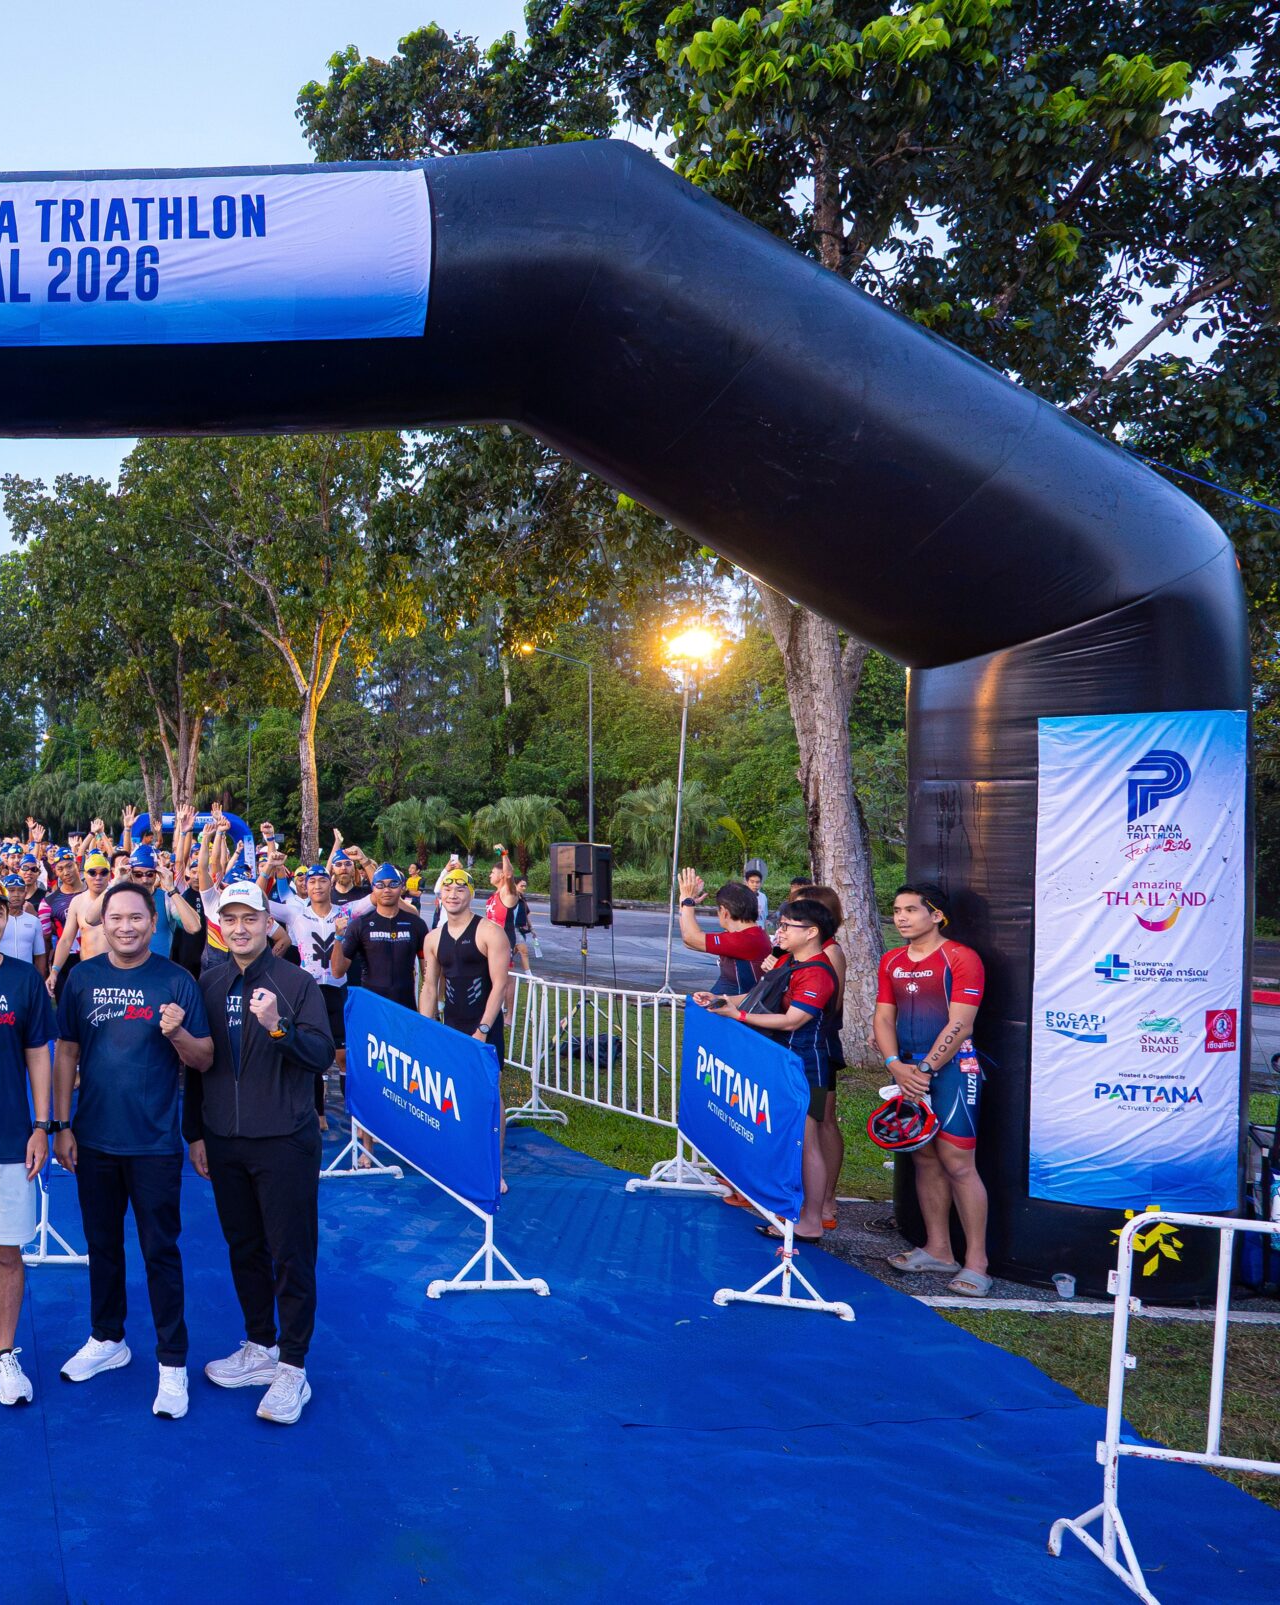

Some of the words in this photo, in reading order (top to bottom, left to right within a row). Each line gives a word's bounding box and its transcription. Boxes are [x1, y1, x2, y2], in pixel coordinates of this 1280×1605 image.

[35, 194, 266, 242] TRIATHLON
[47, 245, 159, 303] 2026
[1127, 824, 1181, 832] PATTANA
[1132, 880, 1182, 891] amazing
[1102, 892, 1207, 906] THAILAND
[899, 970, 933, 978] BEYOND
[93, 988, 144, 998] PATTANA
[93, 997, 144, 1006] TRIATHLON
[87, 1003, 127, 1027] Festival
[1046, 1011, 1105, 1024] POCARI
[1046, 1020, 1101, 1031] SWEAT
[1139, 1035, 1179, 1045] SNAKE
[1141, 1045, 1179, 1053] BRAND
[367, 1033, 461, 1121] PATTANA
[696, 1045, 771, 1134] PATTANA
[1094, 1083, 1203, 1103] PATTANA
[382, 1086, 408, 1108] ACTIVELY
[408, 1102, 440, 1131] TOGETHER
[707, 1100, 728, 1124] ACTIVELY
[728, 1116, 754, 1144] TOGETHER
